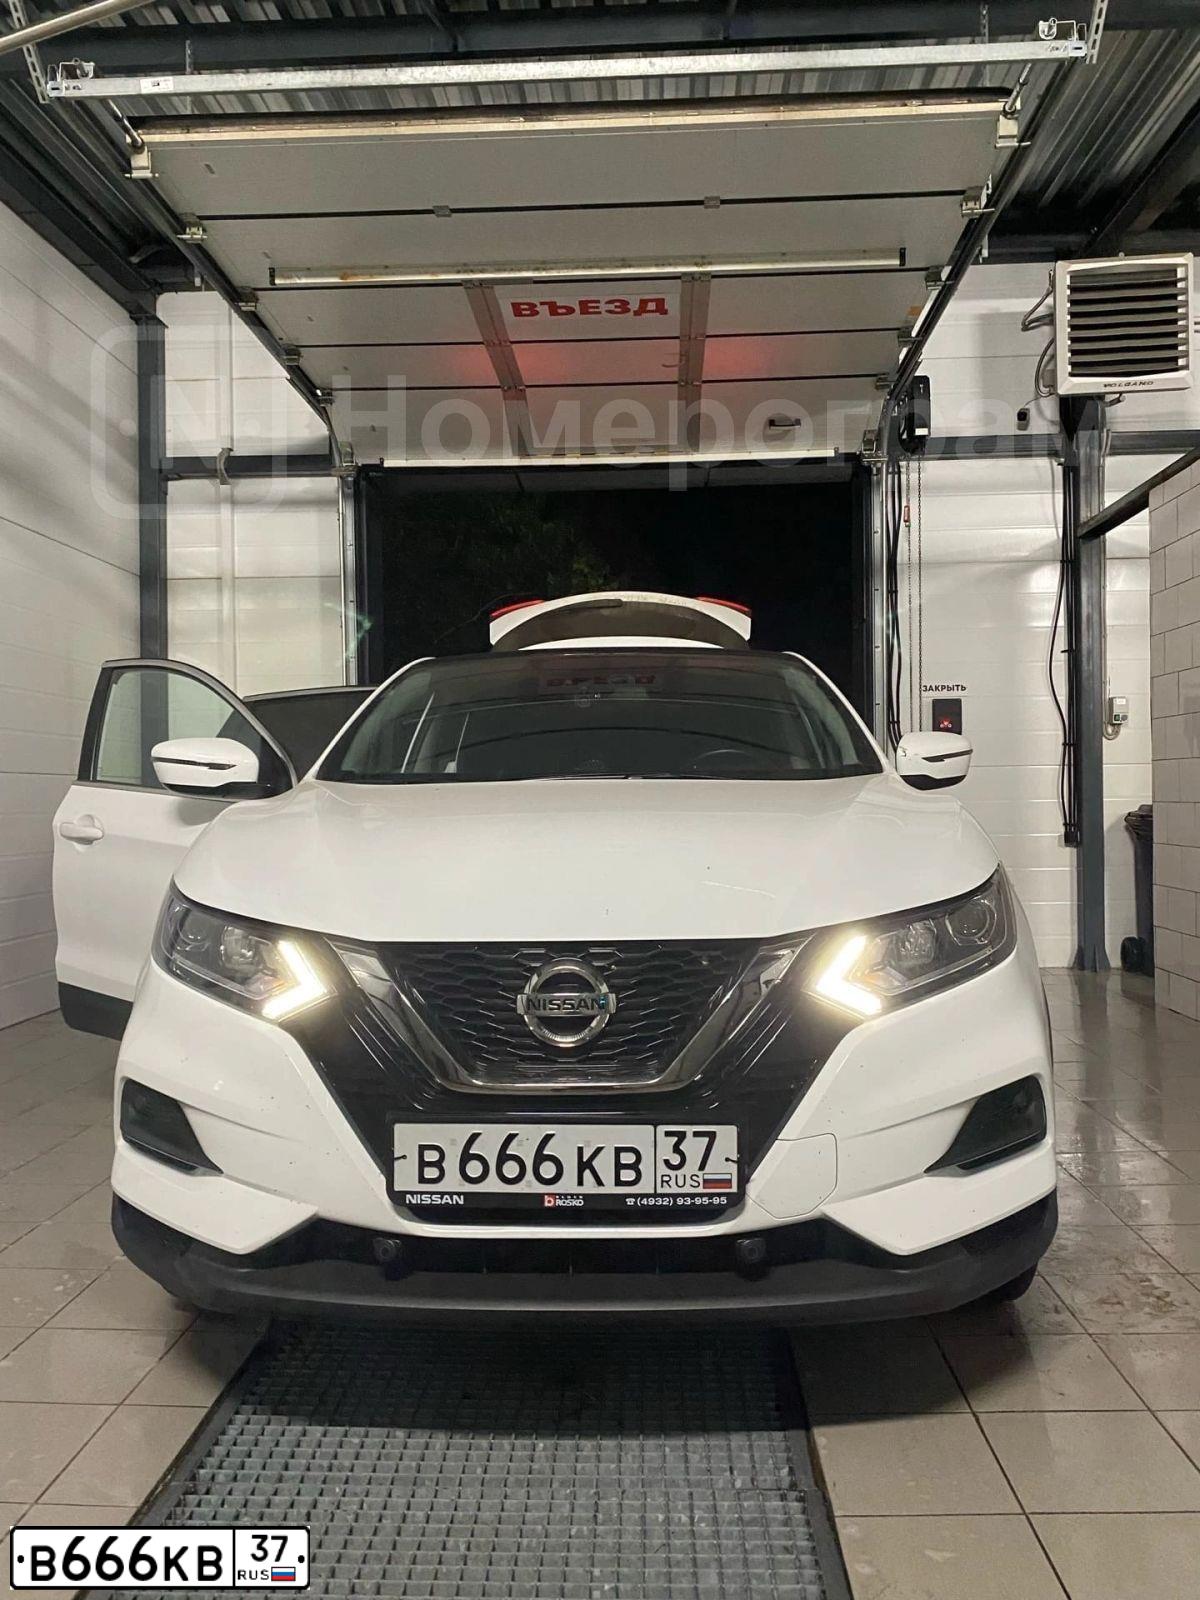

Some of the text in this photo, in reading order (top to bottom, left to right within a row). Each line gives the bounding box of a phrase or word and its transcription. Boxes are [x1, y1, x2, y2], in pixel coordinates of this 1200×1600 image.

[511, 298, 668, 317] ВЪЕЗД
[922, 684, 967, 692] ЗАКРЫТЬ
[526, 998, 606, 1011] NISSAN
[662, 1130, 718, 1172] 37
[660, 1174, 701, 1188] RUS
[405, 1194, 465, 1205] NISSAN
[636, 1196, 728, 1206] (4932) 93-95-95
